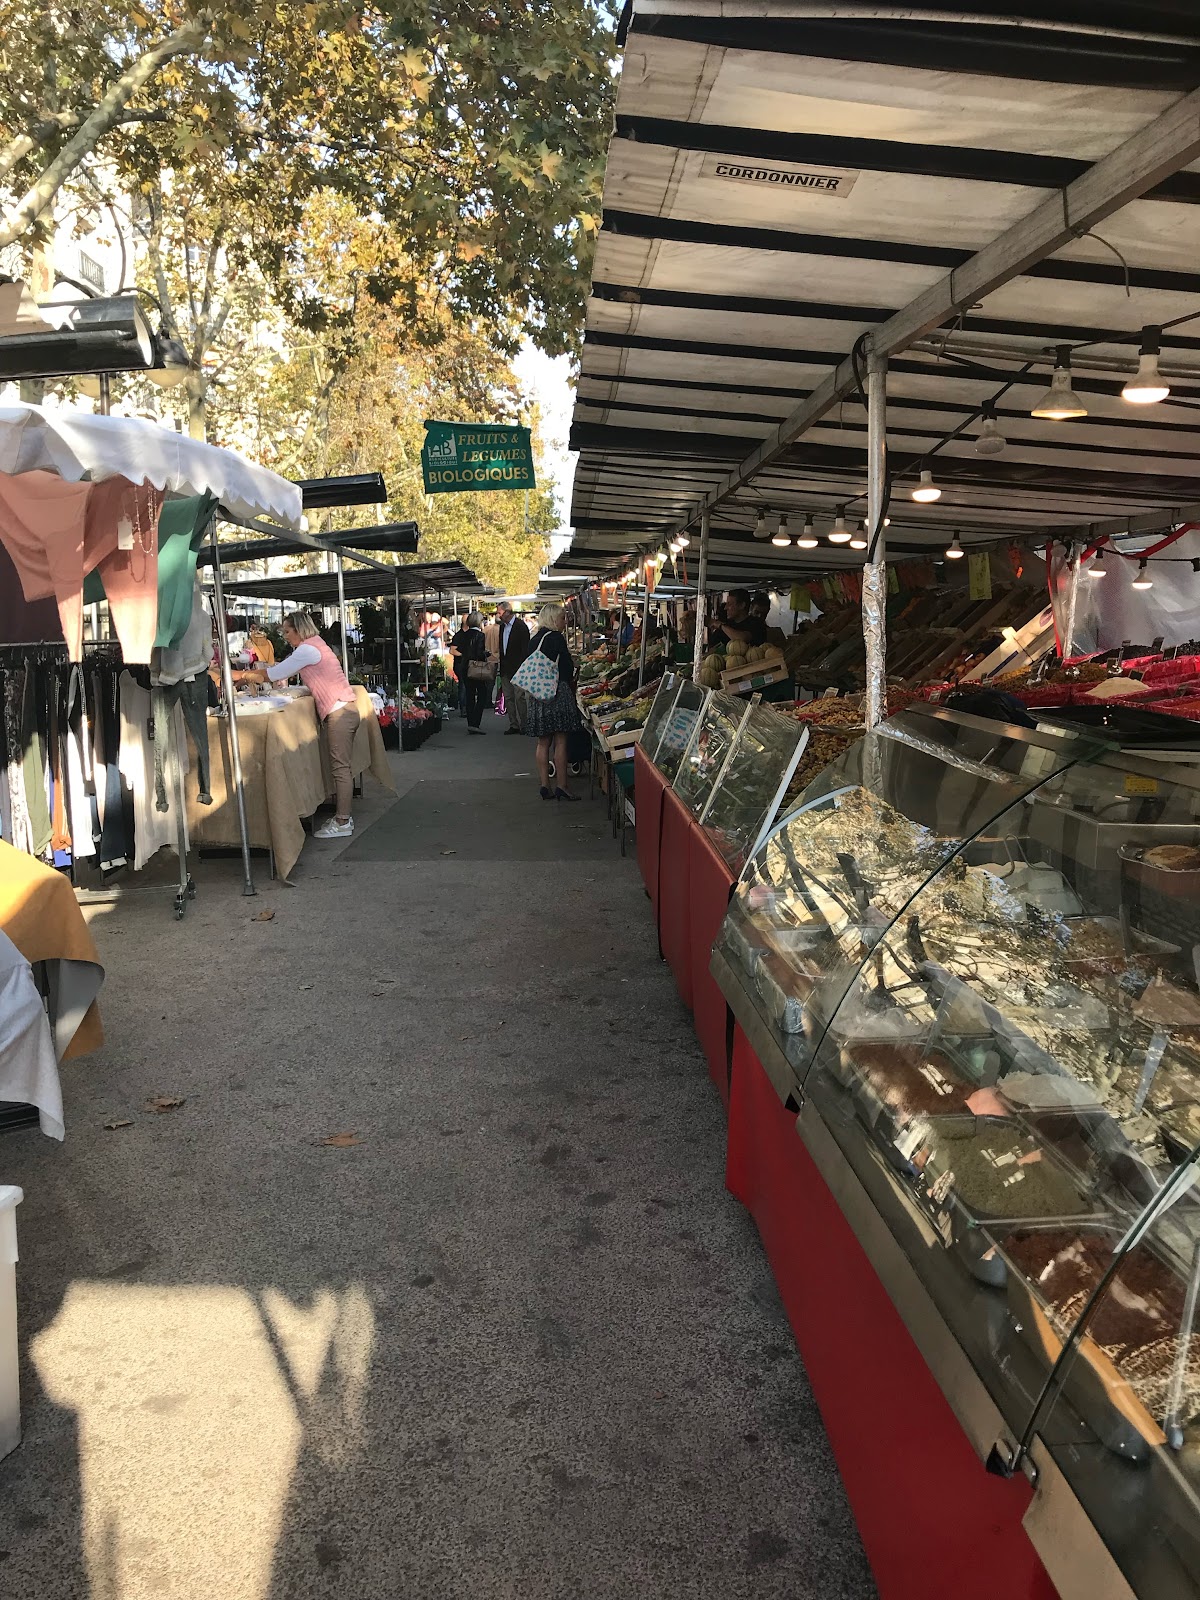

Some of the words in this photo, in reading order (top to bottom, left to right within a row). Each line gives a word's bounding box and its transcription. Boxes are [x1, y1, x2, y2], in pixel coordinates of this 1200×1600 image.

[716, 165, 840, 190] CORDONNIER
[458, 432, 508, 446] FRUITS
[511, 433, 519, 443] &
[462, 448, 527, 462] LEGUMES
[428, 467, 529, 484] BIOLOGIQUES
